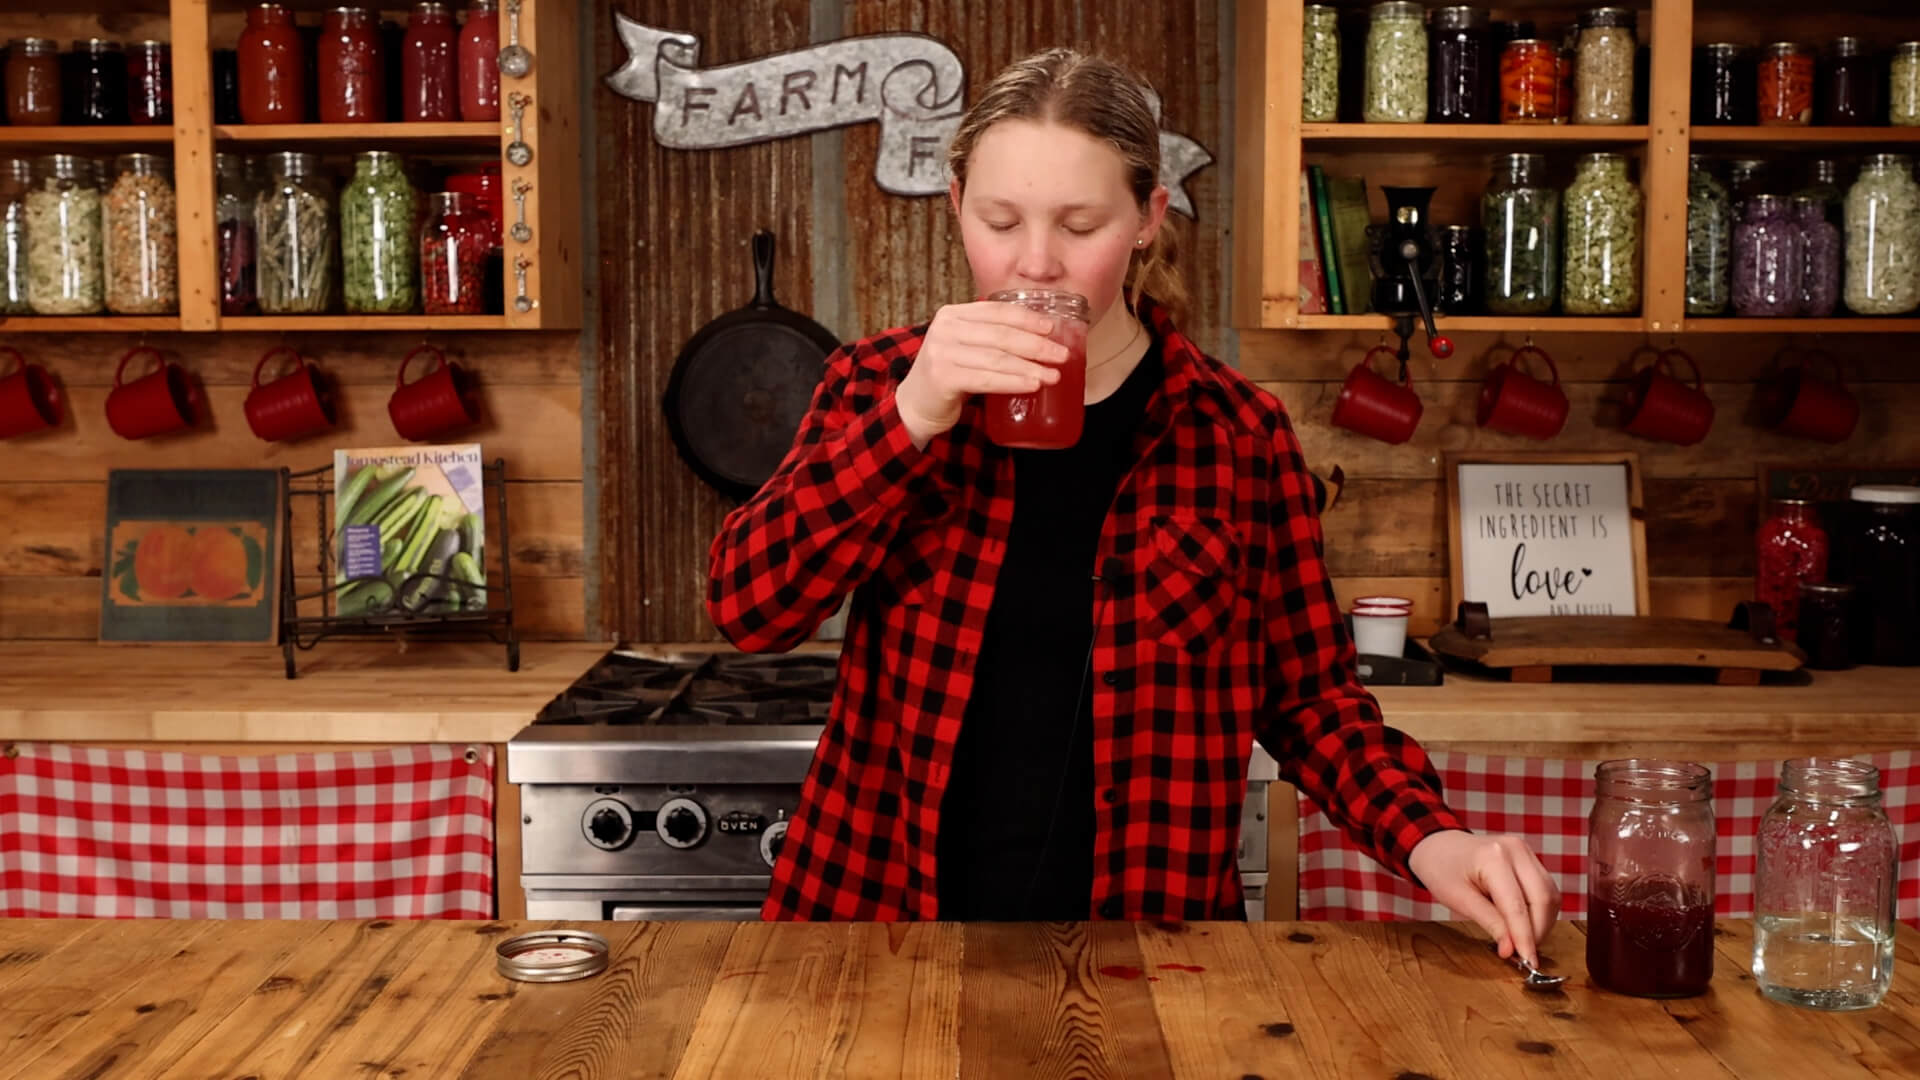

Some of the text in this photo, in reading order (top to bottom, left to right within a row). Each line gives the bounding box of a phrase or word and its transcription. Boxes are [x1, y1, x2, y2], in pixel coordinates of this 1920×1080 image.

[679, 61, 868, 127] FARM
[423, 450, 479, 465] Kitchen
[1494, 482, 1592, 508] THE SECRET
[1479, 513, 1608, 539] INGREDIENT IS
[1511, 542, 1583, 600] love
[720, 820, 758, 831] OVEN
